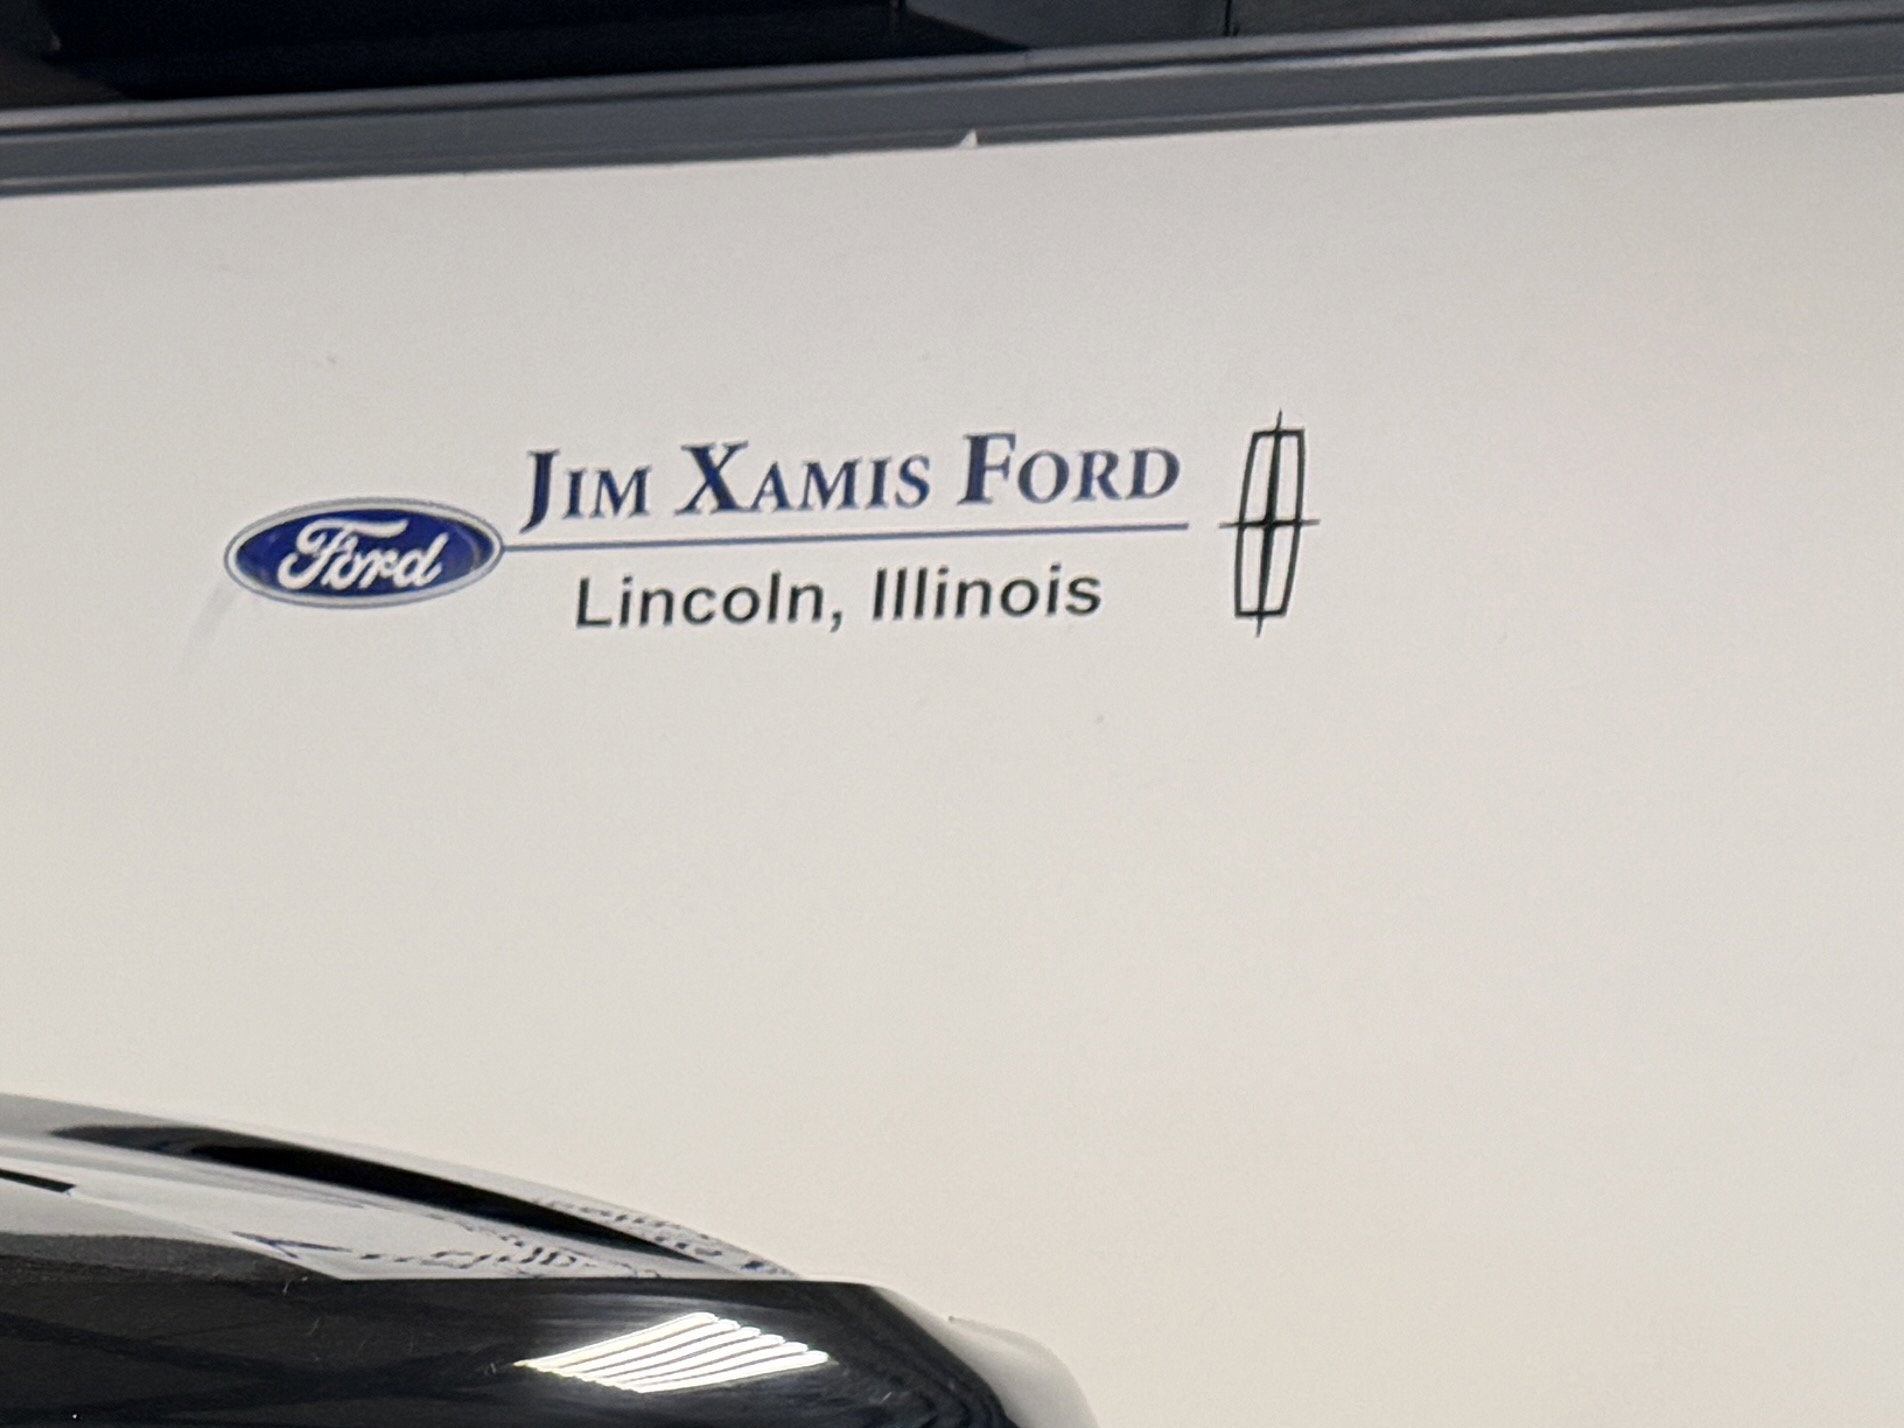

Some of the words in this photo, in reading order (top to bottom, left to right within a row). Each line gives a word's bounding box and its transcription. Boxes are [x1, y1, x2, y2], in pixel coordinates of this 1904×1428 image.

[519, 448, 650, 533] JIM
[674, 440, 931, 516] XAMIS
[956, 432, 1181, 505] FORD
[277, 517, 445, 591] Ford
[575, 571, 842, 634] Lincoln,
[871, 564, 1102, 621] Illinois
